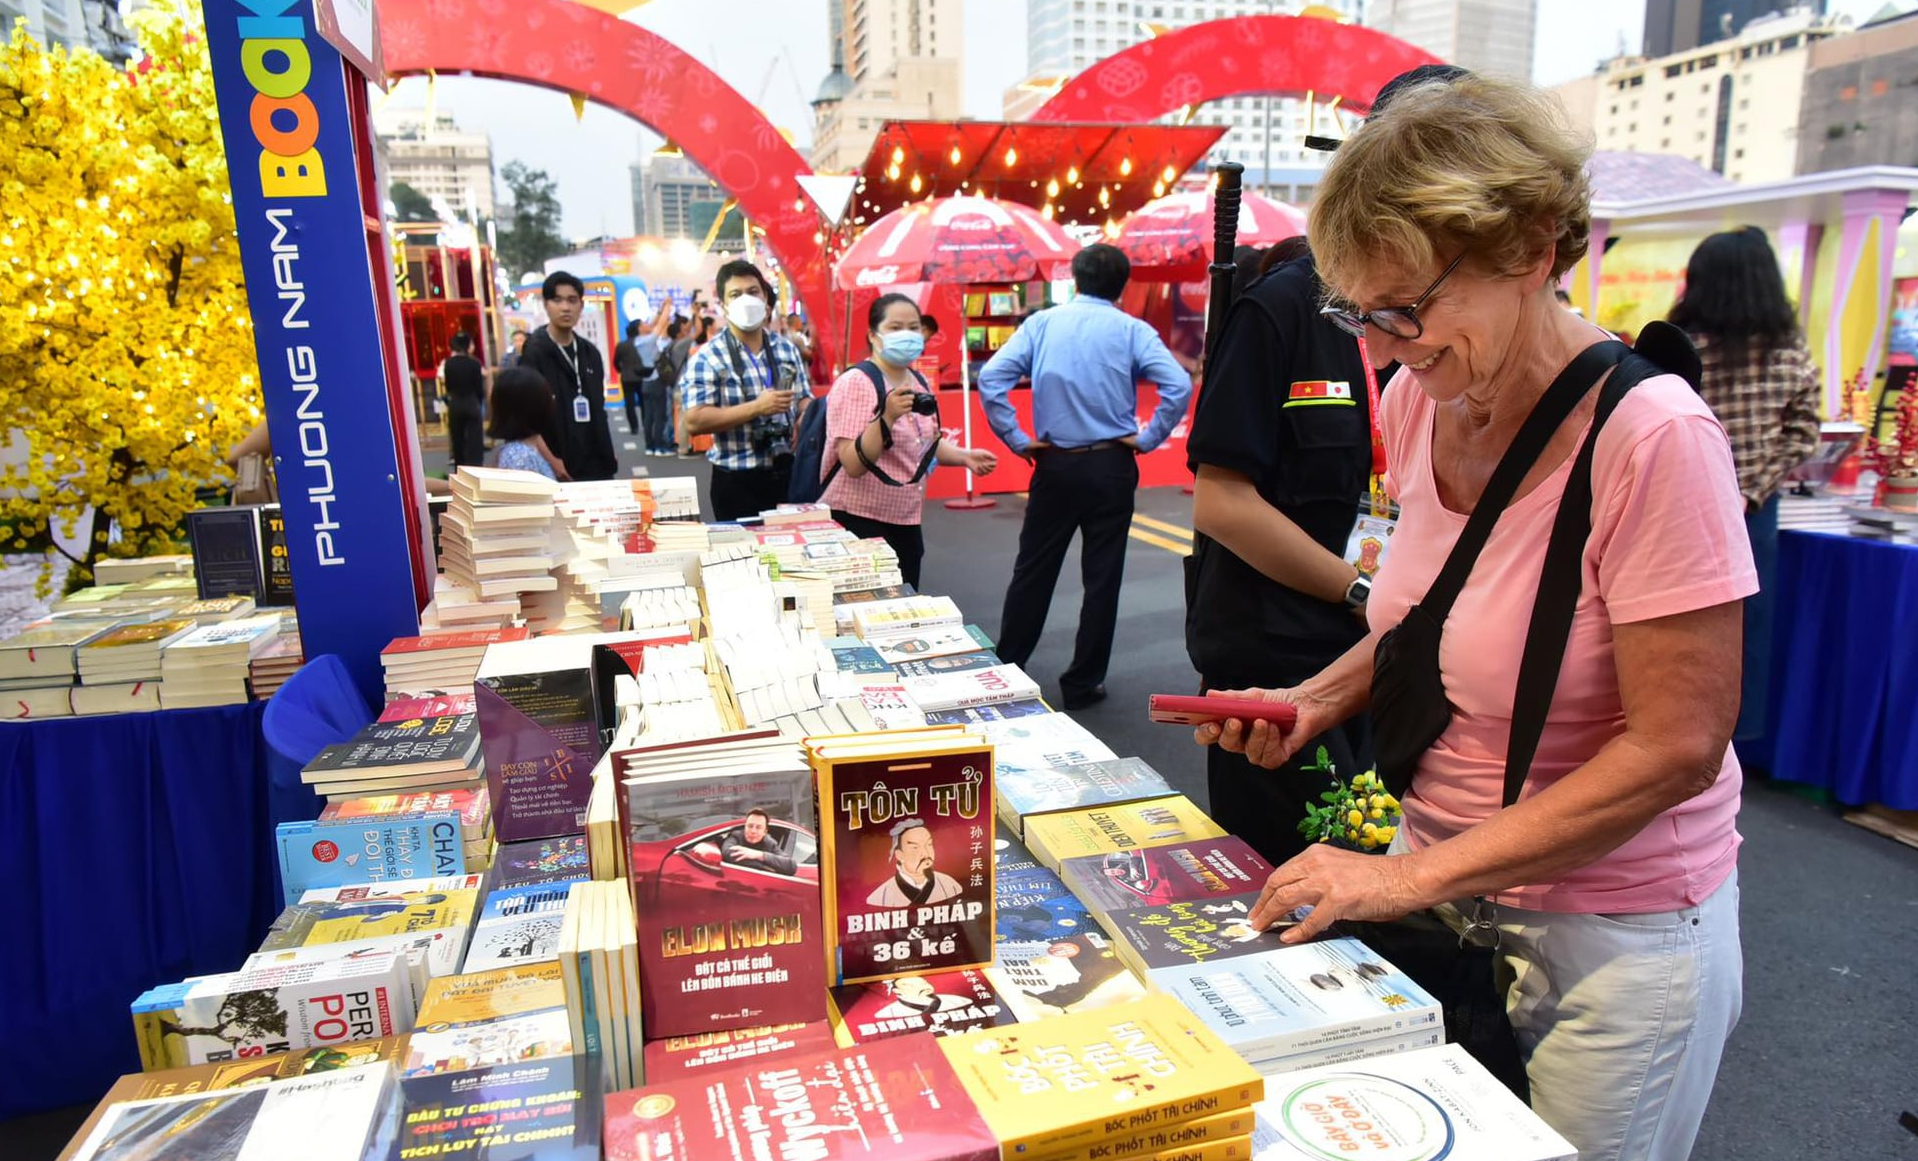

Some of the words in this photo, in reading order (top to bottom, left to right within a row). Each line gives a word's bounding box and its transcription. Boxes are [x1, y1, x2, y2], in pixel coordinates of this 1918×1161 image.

[265, 207, 310, 329] NAM
[286, 345, 346, 567] PHUONG
[841, 781, 919, 831] TÔN
[929, 766, 984, 821] TỬ
[396, 827, 413, 864] THAY
[969, 825, 984, 888] 孙子兵法
[846, 909, 909, 934] BINH
[916, 898, 984, 927] PHÁP
[906, 926, 927, 941] &
[661, 921, 726, 958] ELON
[729, 912, 803, 950] MUSK
[873, 940, 911, 963] 36
[920, 932, 958, 958] kế
[681, 978, 701, 993] LÊN
[701, 976, 722, 991] BỐN
[723, 972, 751, 989] BÁNH
[765, 968, 789, 985] ĐIỆN
[695, 960, 715, 977] ĐẶT
[716, 957, 732, 974] CẢ
[732, 954, 750, 971] THẾ
[751, 952, 773, 969] GIỚI
[858, 1015, 927, 1037] BINH
[930, 1004, 1002, 1025] PHÁP
[1107, 1020, 1178, 1079] CHÍNH
[451, 1076, 478, 1087] Lâm
[481, 1072, 511, 1083] Minh
[512, 1066, 550, 1078] Chánh
[406, 1107, 441, 1124] ĐẦU
[443, 1104, 467, 1118] TƯ
[757, 1067, 830, 1161] Wyckoff
[1104, 1116, 1127, 1134] BÓC
[1129, 1108, 1161, 1128] PHỐT
[1162, 1103, 1183, 1120] TÀI
[1183, 1095, 1219, 1116] CHÍNH
[1325, 1094, 1362, 1120] ĐÂY
[473, 1123, 505, 1136] HAY
[1089, 1141, 1113, 1160] BÓC
[1115, 1133, 1147, 1155] PHỐT
[1148, 1132, 1169, 1149] TÀI
[1169, 1125, 1208, 1143] CHÍNH
